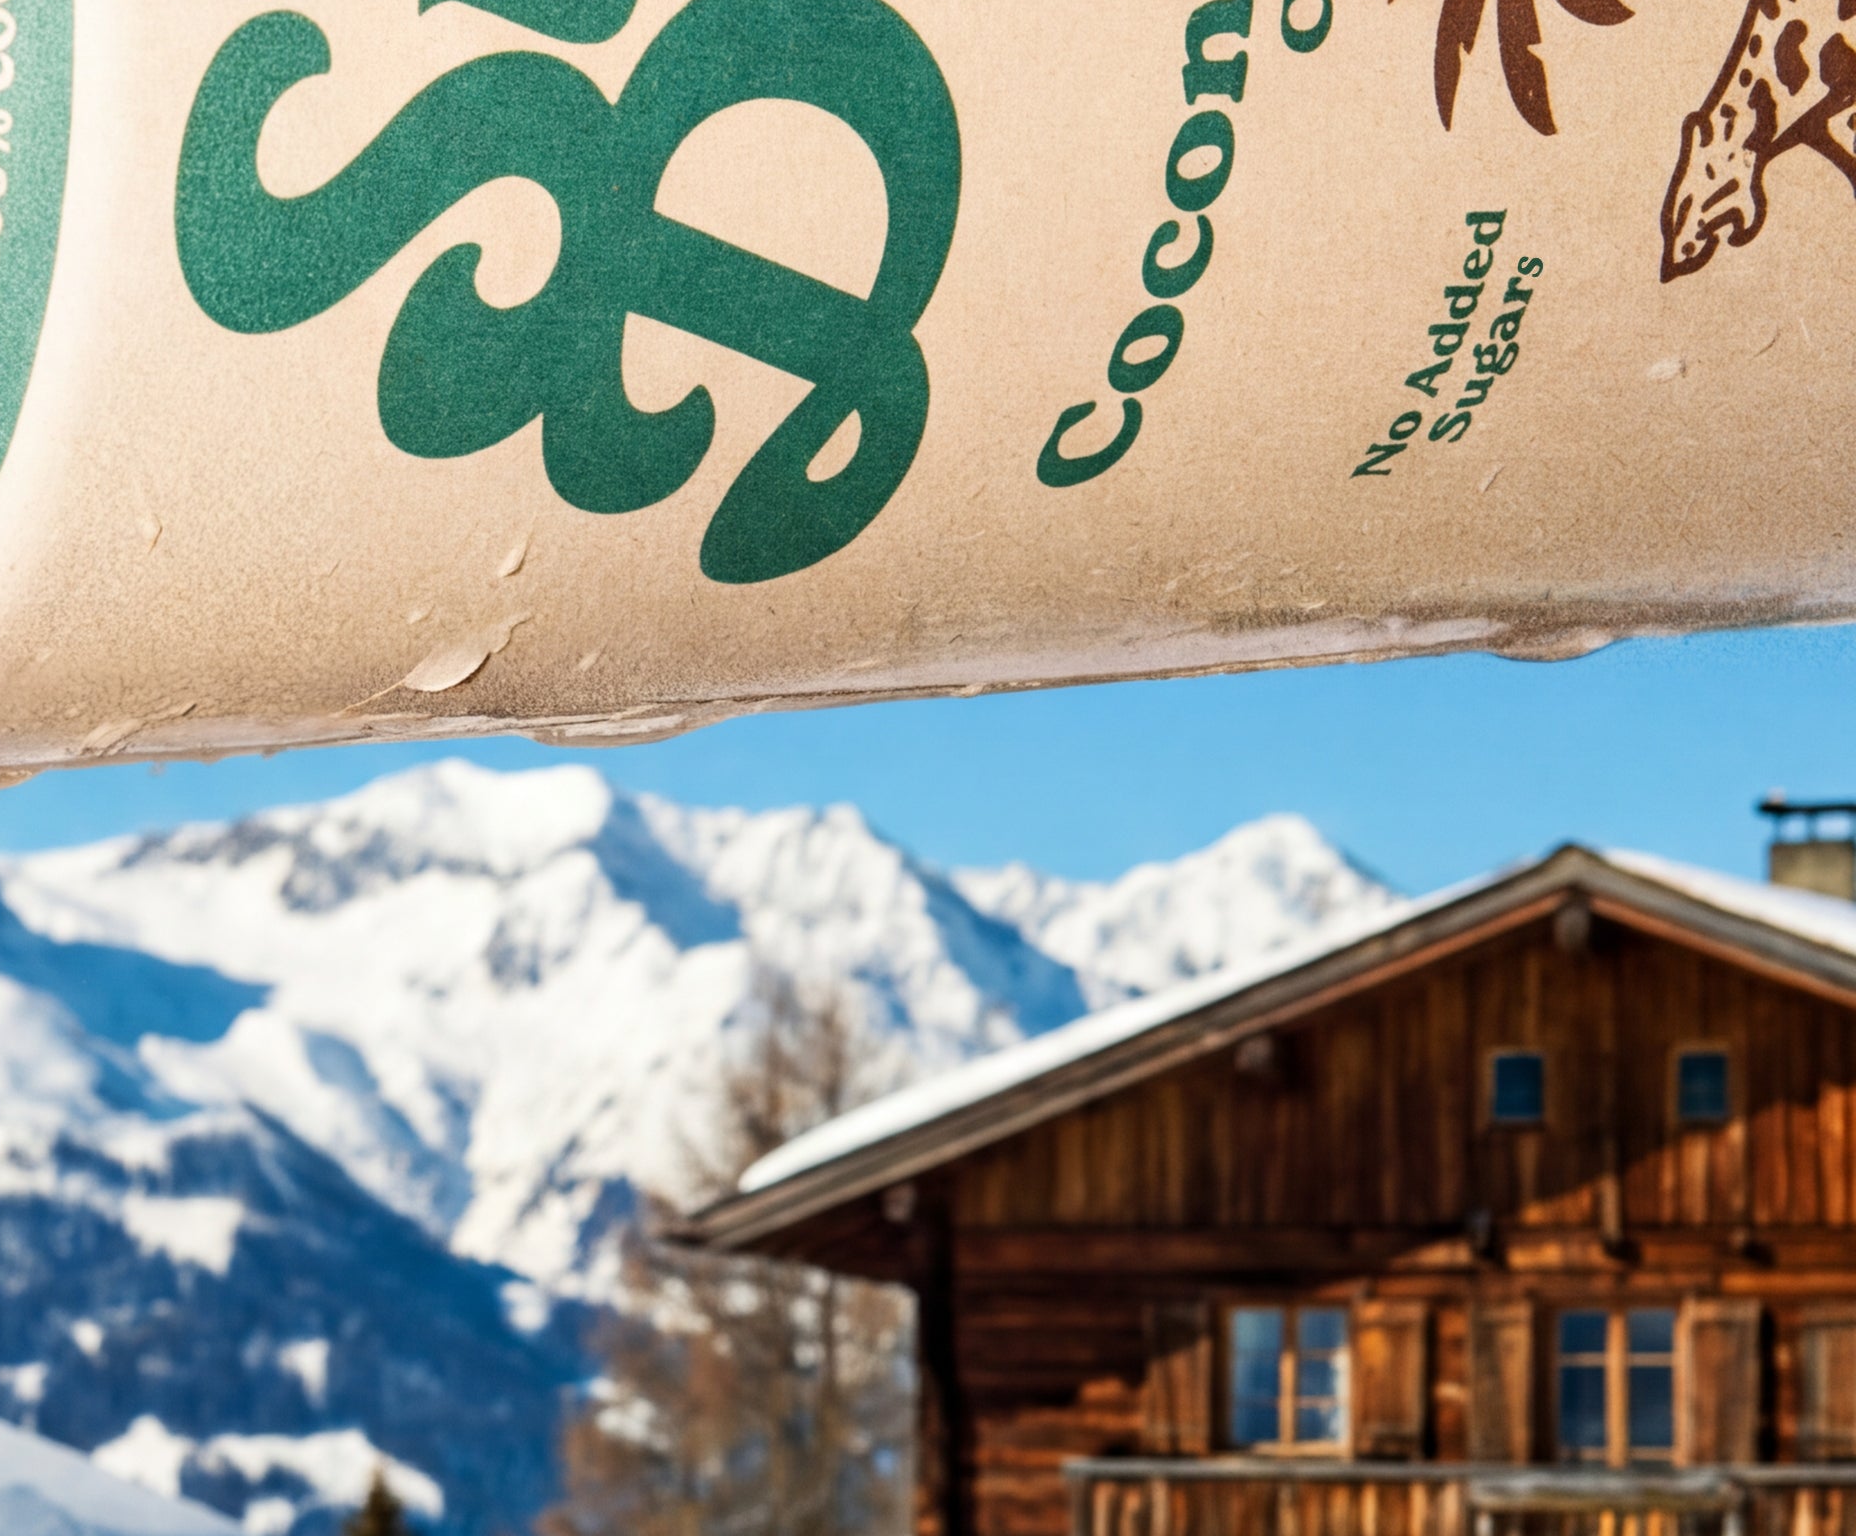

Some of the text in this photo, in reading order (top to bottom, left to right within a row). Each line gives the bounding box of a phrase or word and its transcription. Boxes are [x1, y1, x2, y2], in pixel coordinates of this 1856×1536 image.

[1351, 209, 1506, 478] No Added
[1428, 255, 1544, 442] Sugars
